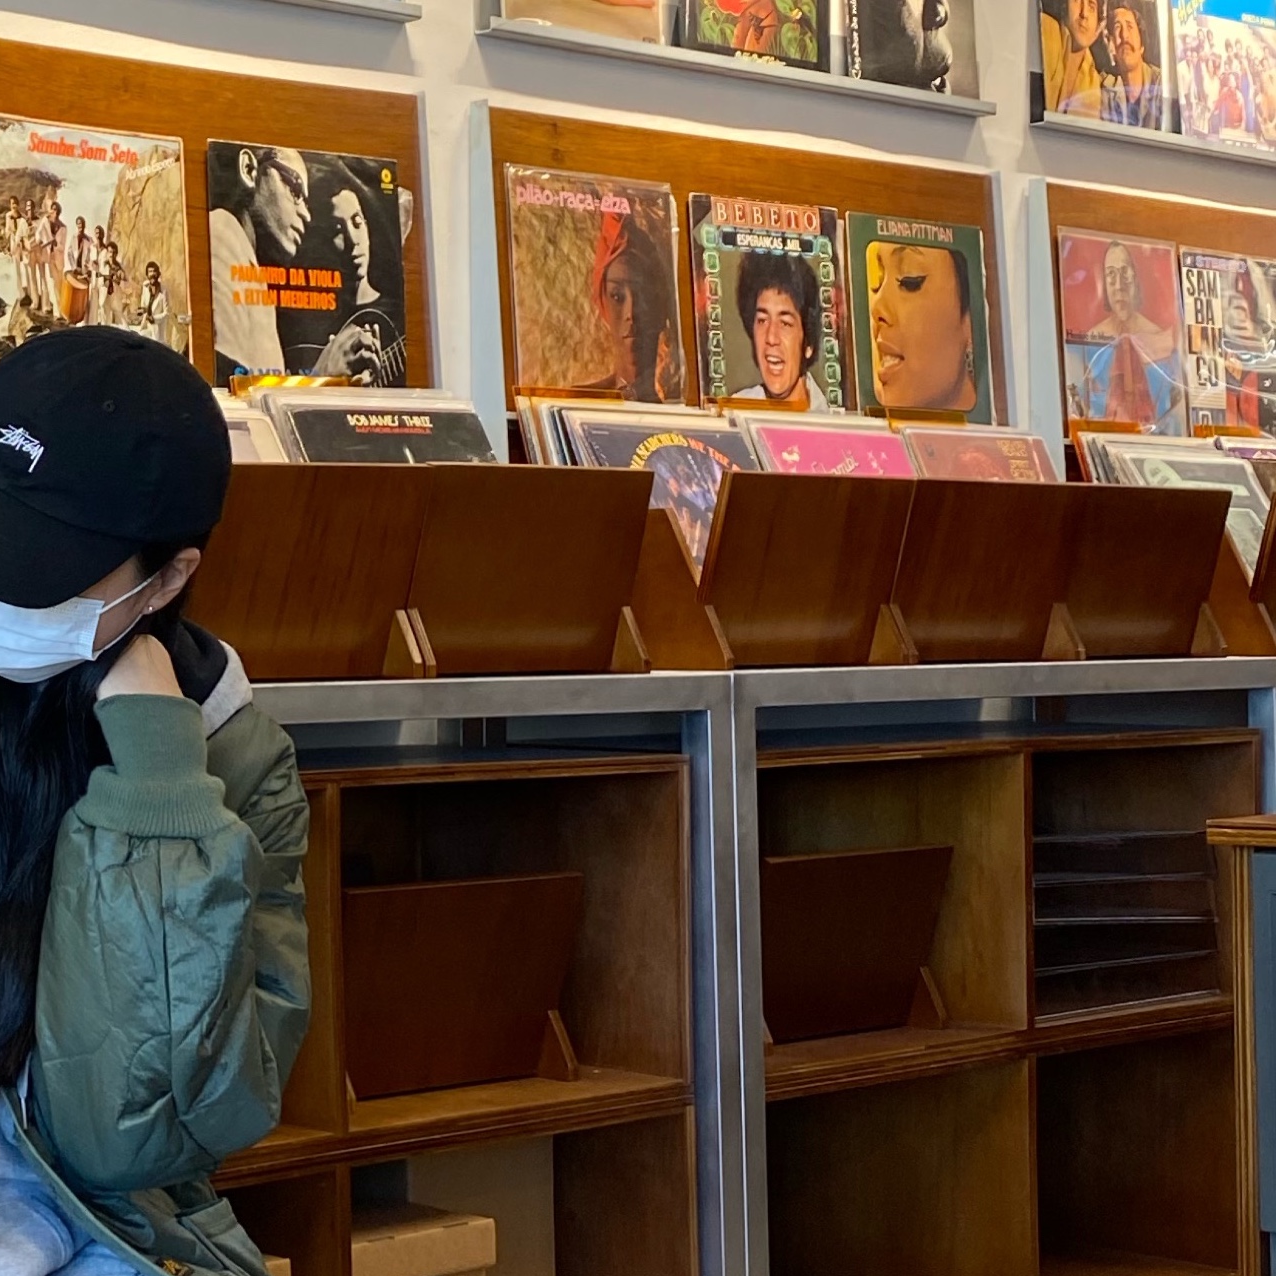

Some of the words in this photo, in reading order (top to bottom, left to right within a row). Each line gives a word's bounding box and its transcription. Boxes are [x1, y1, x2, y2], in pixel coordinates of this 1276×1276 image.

[27, 131, 76, 158] Samba
[77, 139, 108, 162] Som
[716, 202, 818, 231] BEBETO
[877, 219, 911, 238] ELIANA
[911, 223, 954, 243] PITTMAN
[230, 265, 286, 285] PAULINHO
[289, 268, 306, 286] DA
[308, 269, 342, 288] VIOLA
[1185, 268, 1219, 299] SAM
[280, 289, 337, 311] MEDEIROS
[1194, 297, 1215, 326] BA
[402, 415, 434, 428] THREE
